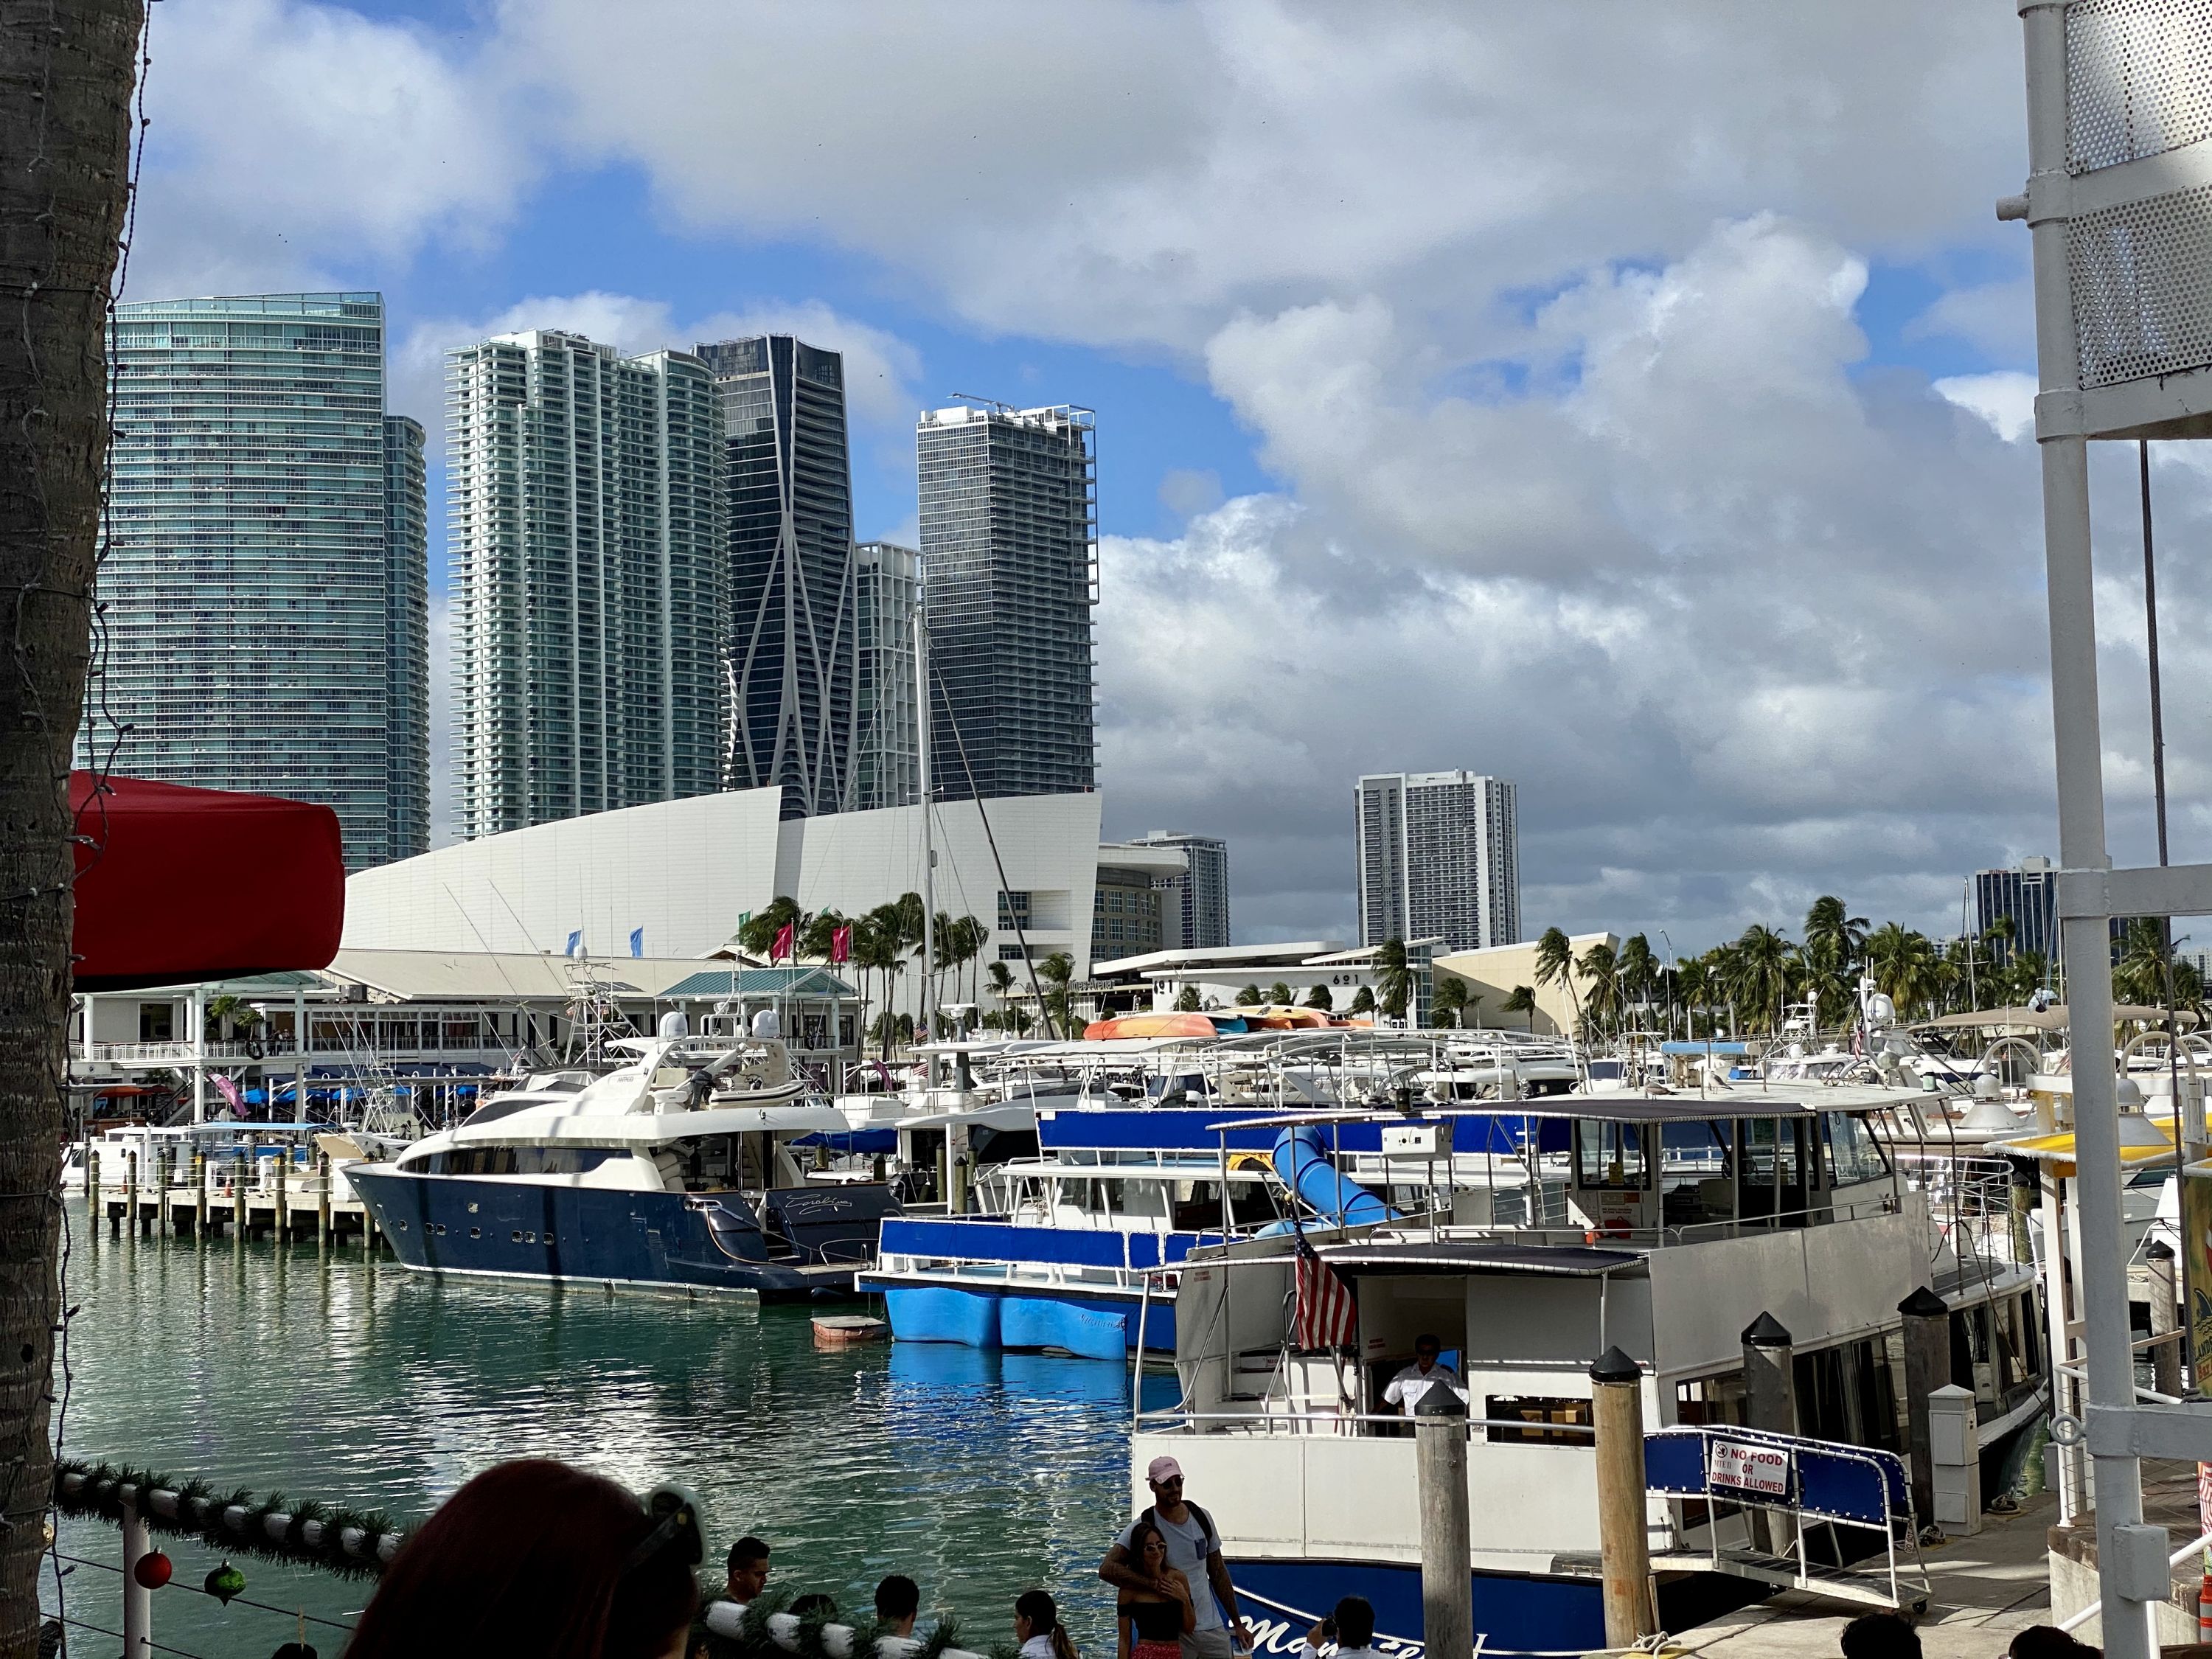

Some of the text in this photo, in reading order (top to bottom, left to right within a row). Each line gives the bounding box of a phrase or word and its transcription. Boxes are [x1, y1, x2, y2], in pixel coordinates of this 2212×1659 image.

[1153, 979, 1172, 994] 601
[1333, 974, 1358, 985] 601
[1731, 1448, 1783, 1466] NO FOOD
[1742, 1464, 1753, 1475] OR
[1711, 1472, 1784, 1492] DRINKS ALLOWED
